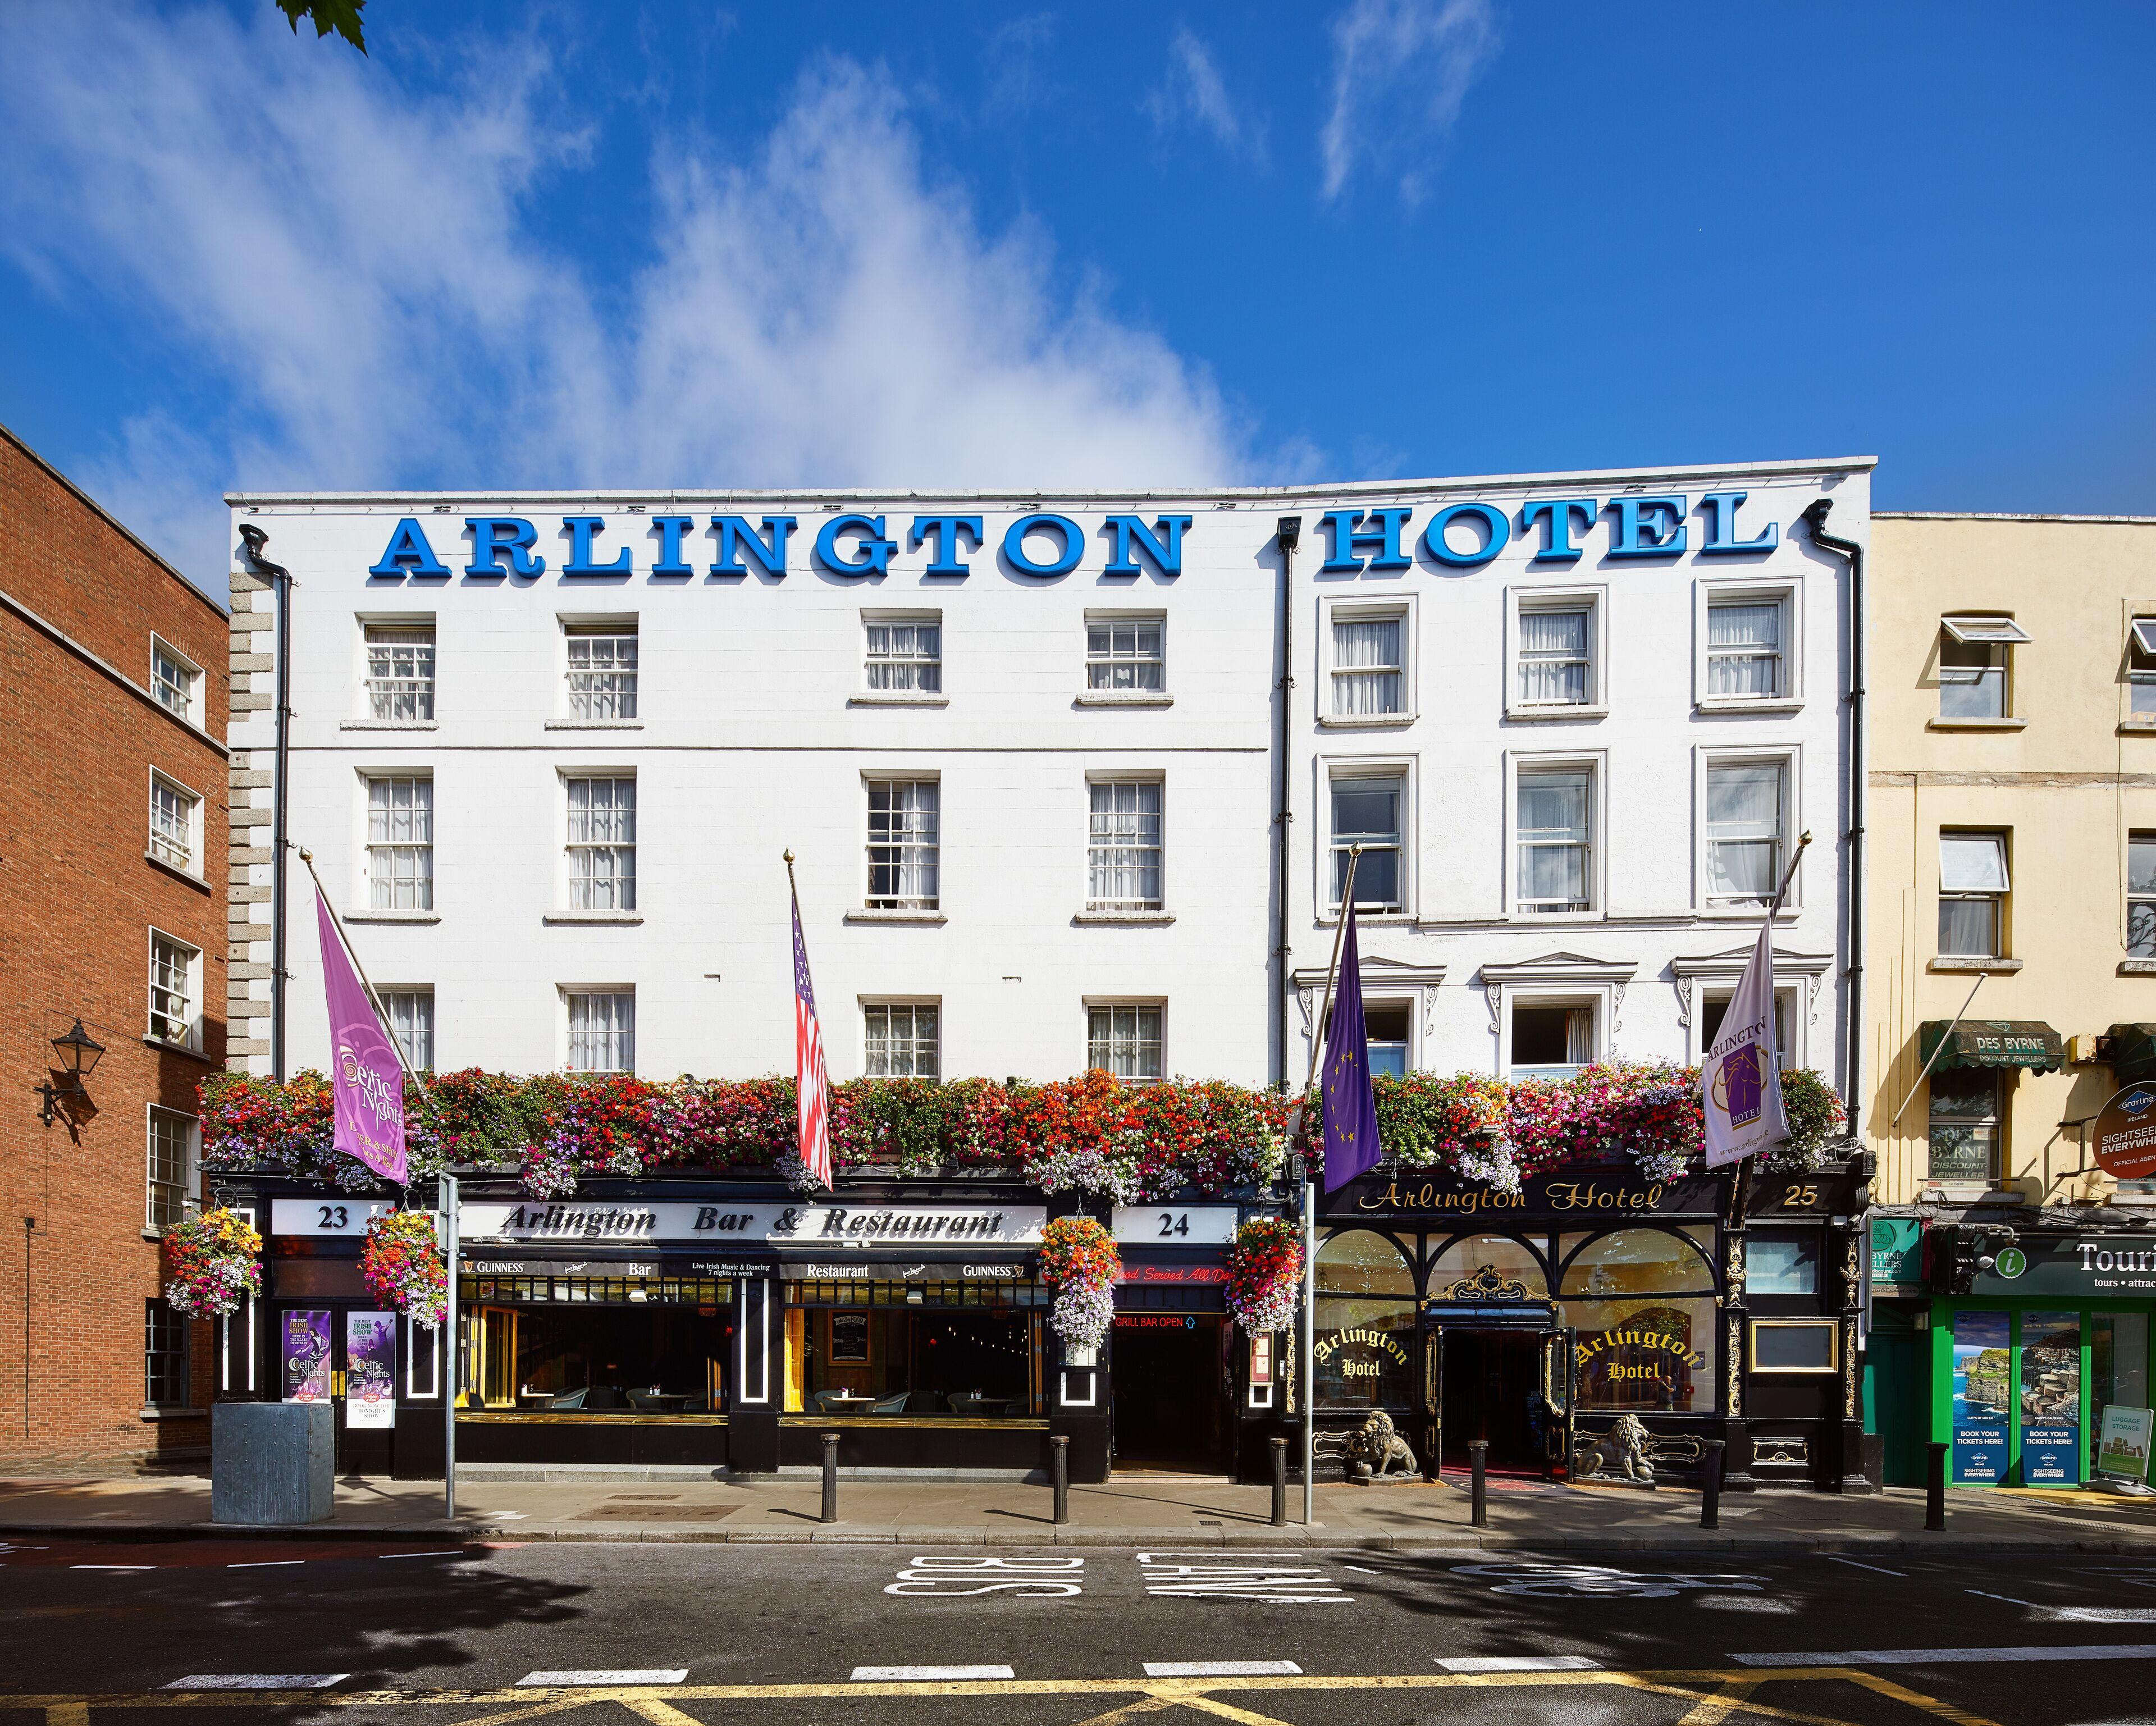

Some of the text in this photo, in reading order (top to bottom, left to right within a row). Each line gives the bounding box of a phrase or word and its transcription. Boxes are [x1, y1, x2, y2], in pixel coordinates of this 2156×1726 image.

[369, 492, 1779, 578] ARLINGTON HOTEL
[1976, 1038, 2045, 1050] DES BYRNE
[1733, 1107, 1761, 1124] HOTEL
[1944, 1129, 1972, 1141] DES
[1932, 1146, 1985, 1158] BYRNE
[2113, 1158, 2138, 1167] OFFICIAL
[1360, 1182, 1662, 1214] Arlington Hotel
[1784, 1185, 1817, 1206] 25
[318, 1206, 348, 1228] 23
[500, 1205, 1003, 1235] Arlington Bar & Restaurant
[1159, 1213, 1189, 1235] 24
[477, 1261, 524, 1273] GUINNESS
[629, 1263, 651, 1276] Bar
[807, 1264, 869, 1277] Restaurant
[963, 1265, 1011, 1276] GUINNESS
[1144, 1268, 1183, 1280] Served
[1185, 1268, 1209, 1280] All
[2094, 1278, 2118, 1287] tours
[1116, 1318, 1183, 1327] GRILL BAR OPEN
[1314, 1326, 1408, 1366] Arlington
[1575, 1328, 1701, 1367] Arlington
[289, 1358, 318, 1371] Celtic
[354, 1358, 383, 1372] Celtic
[1342, 1359, 1381, 1379] Hotel
[1607, 1362, 1661, 1382] Hotel
[884, 1556, 1085, 1596] BUS
